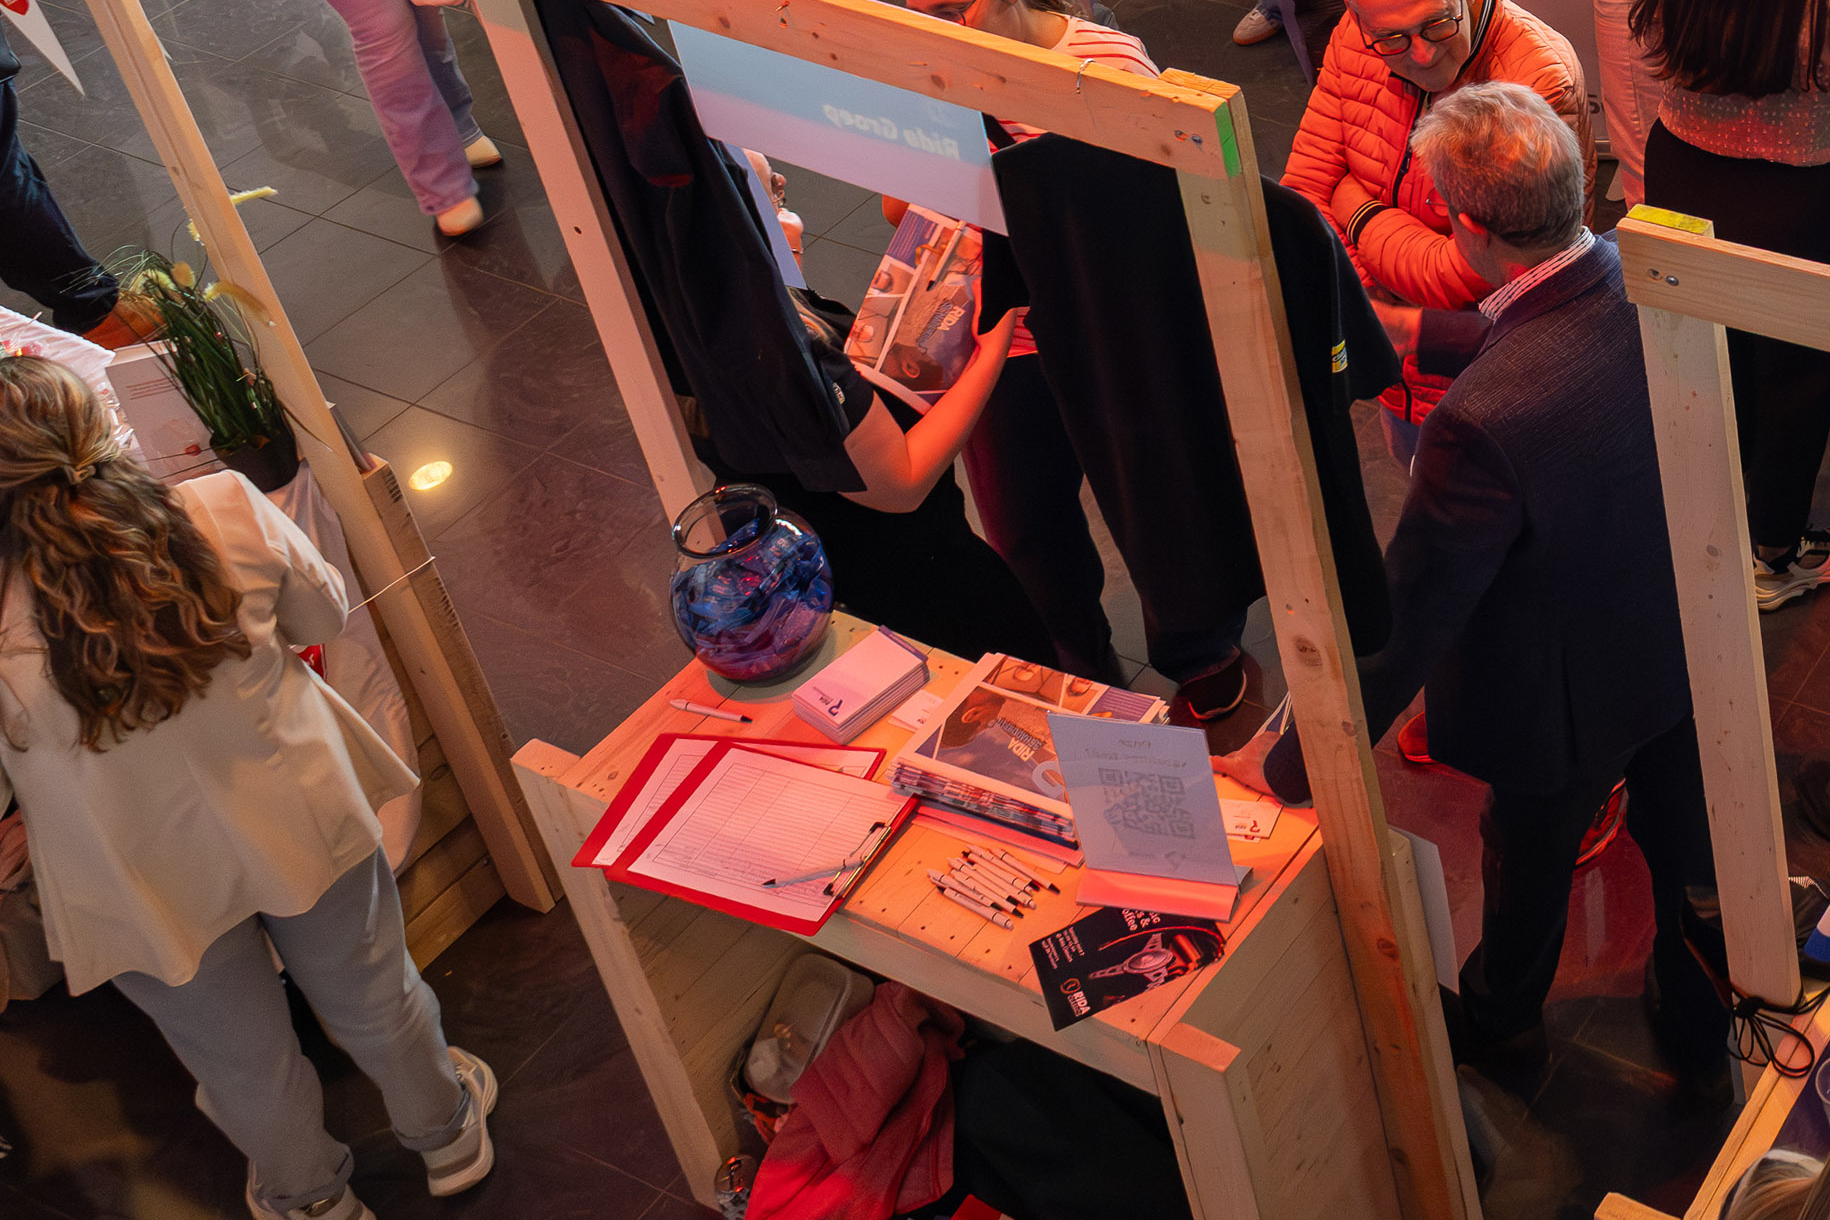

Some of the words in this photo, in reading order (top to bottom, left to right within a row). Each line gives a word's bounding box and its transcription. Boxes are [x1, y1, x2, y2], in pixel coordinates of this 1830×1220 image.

[1008, 736, 1035, 762] RIDA
[1122, 909, 1138, 931] offee
[1073, 990, 1091, 1016] RIDA
